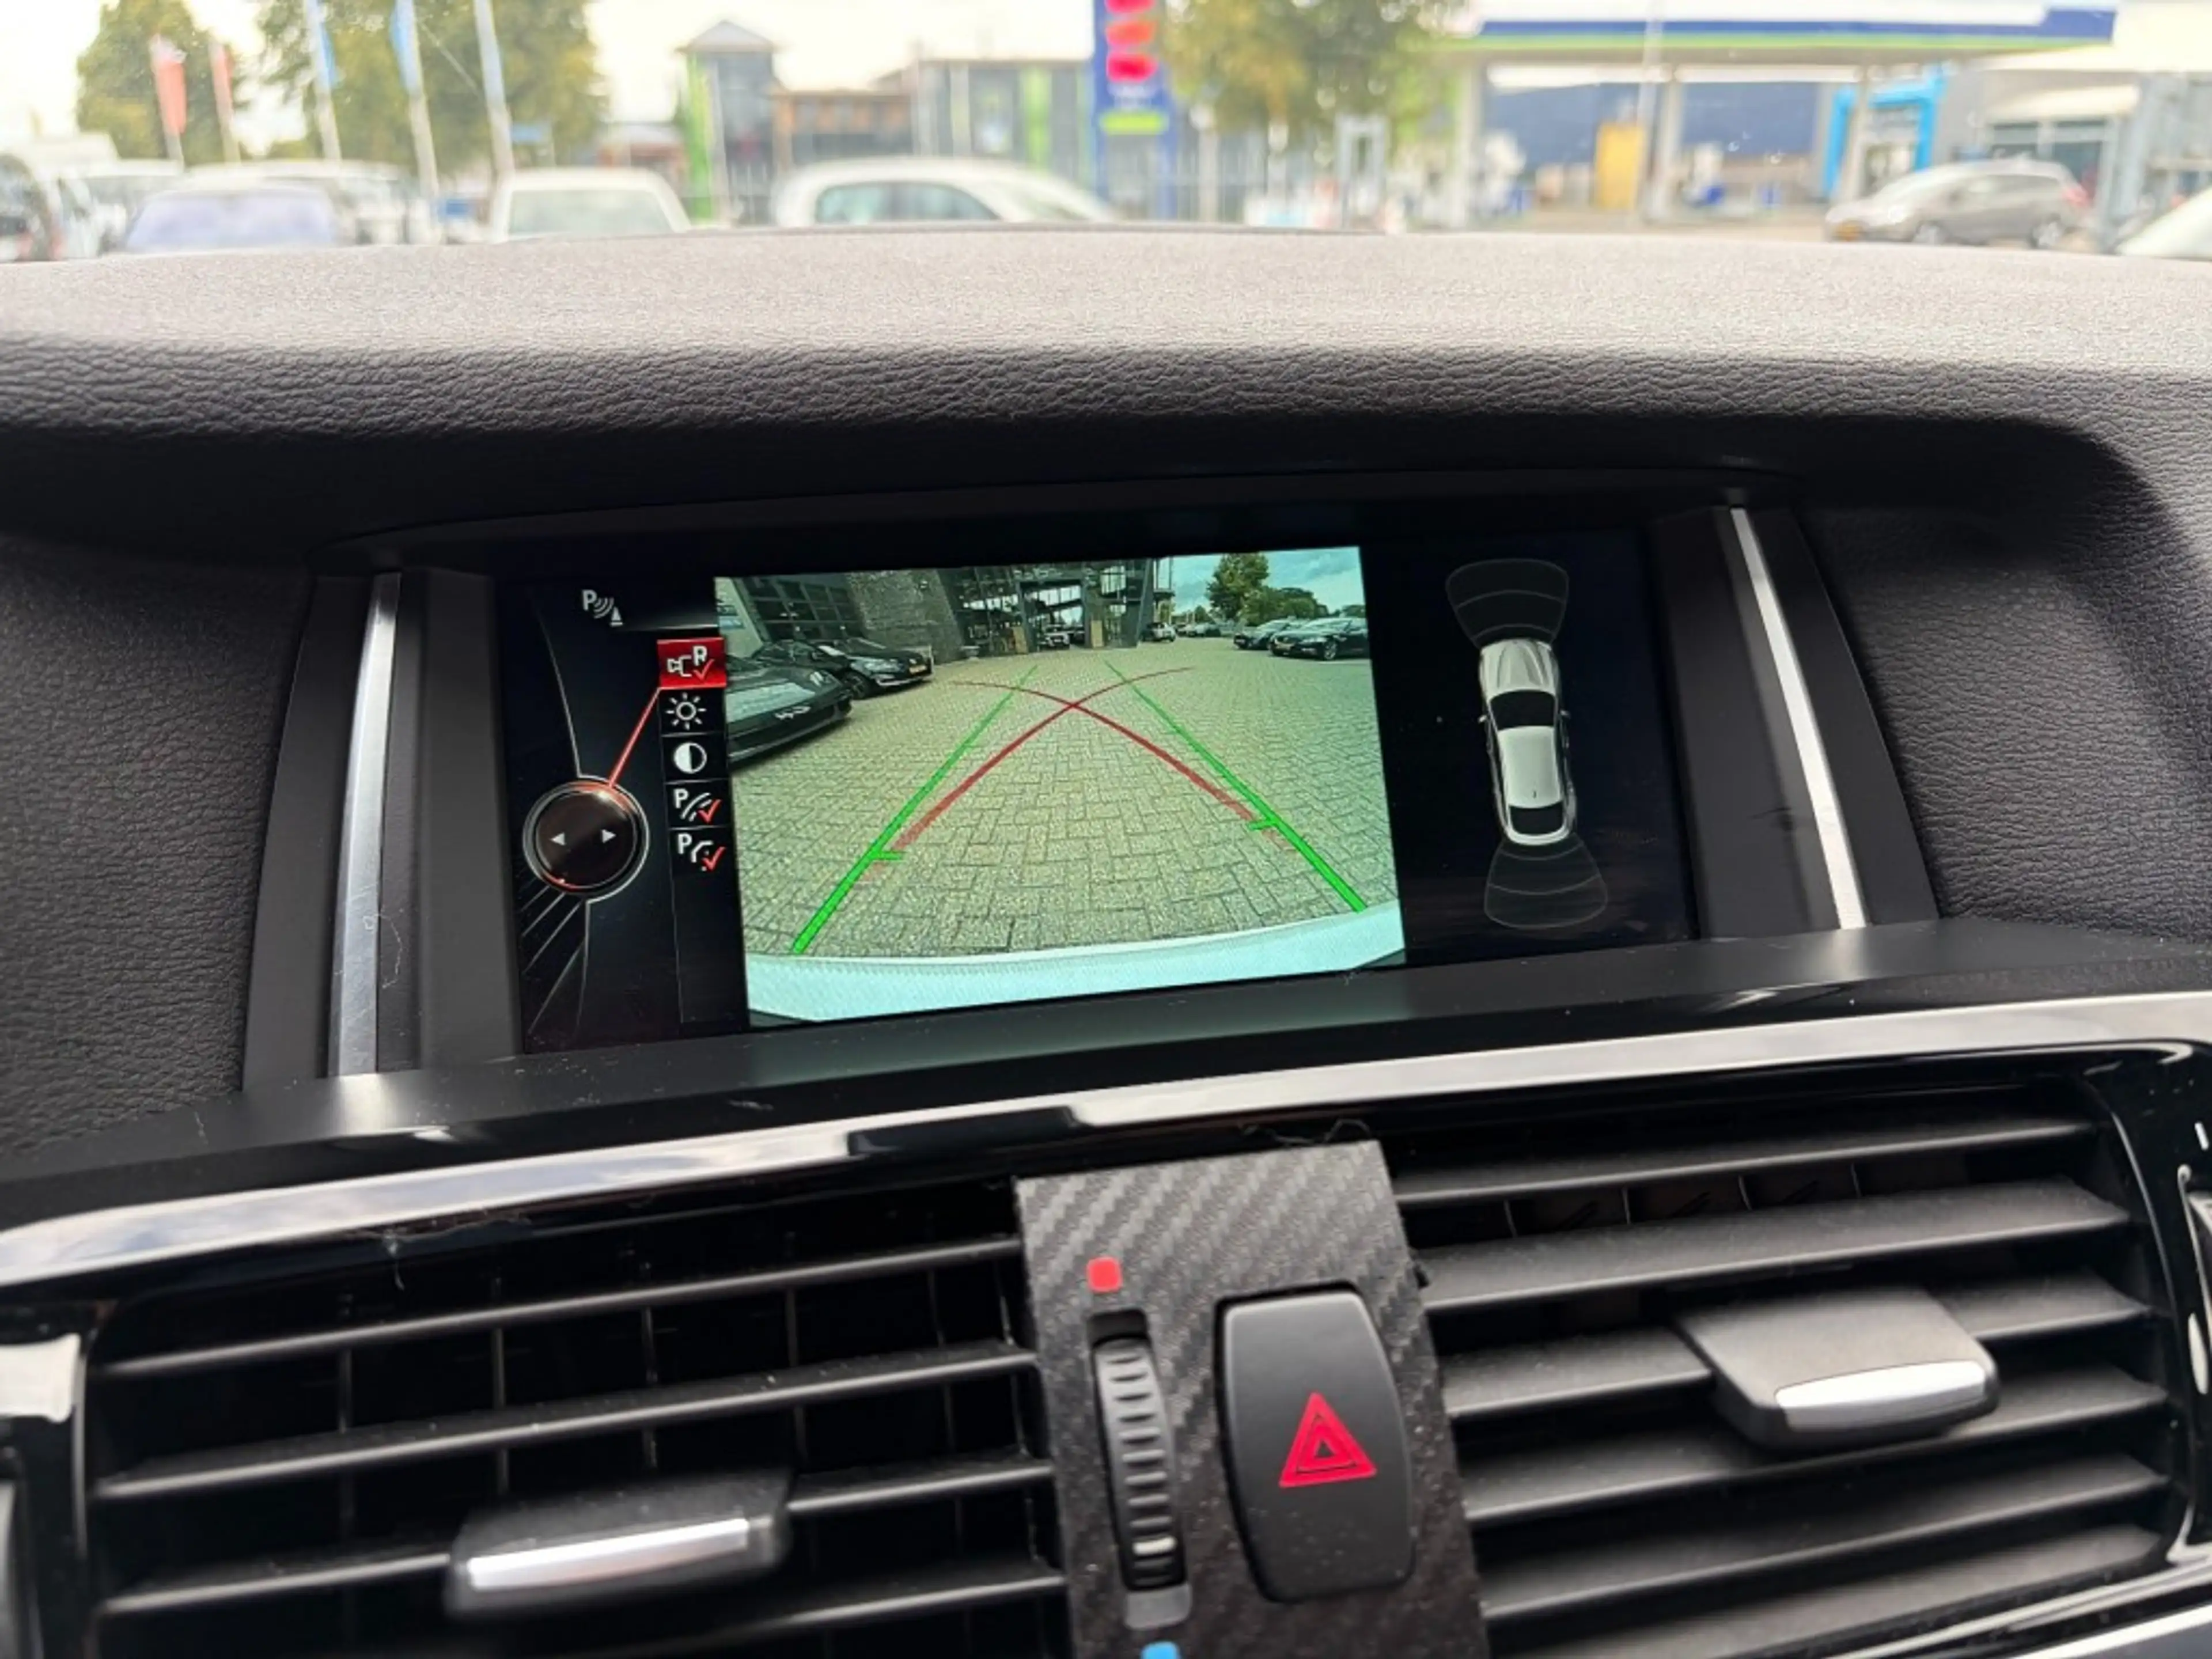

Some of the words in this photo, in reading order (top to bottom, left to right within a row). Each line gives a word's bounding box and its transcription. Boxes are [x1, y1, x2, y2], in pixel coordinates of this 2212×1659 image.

[582, 589, 597, 611] P
[673, 788, 689, 809] P
[677, 833, 692, 855] P
